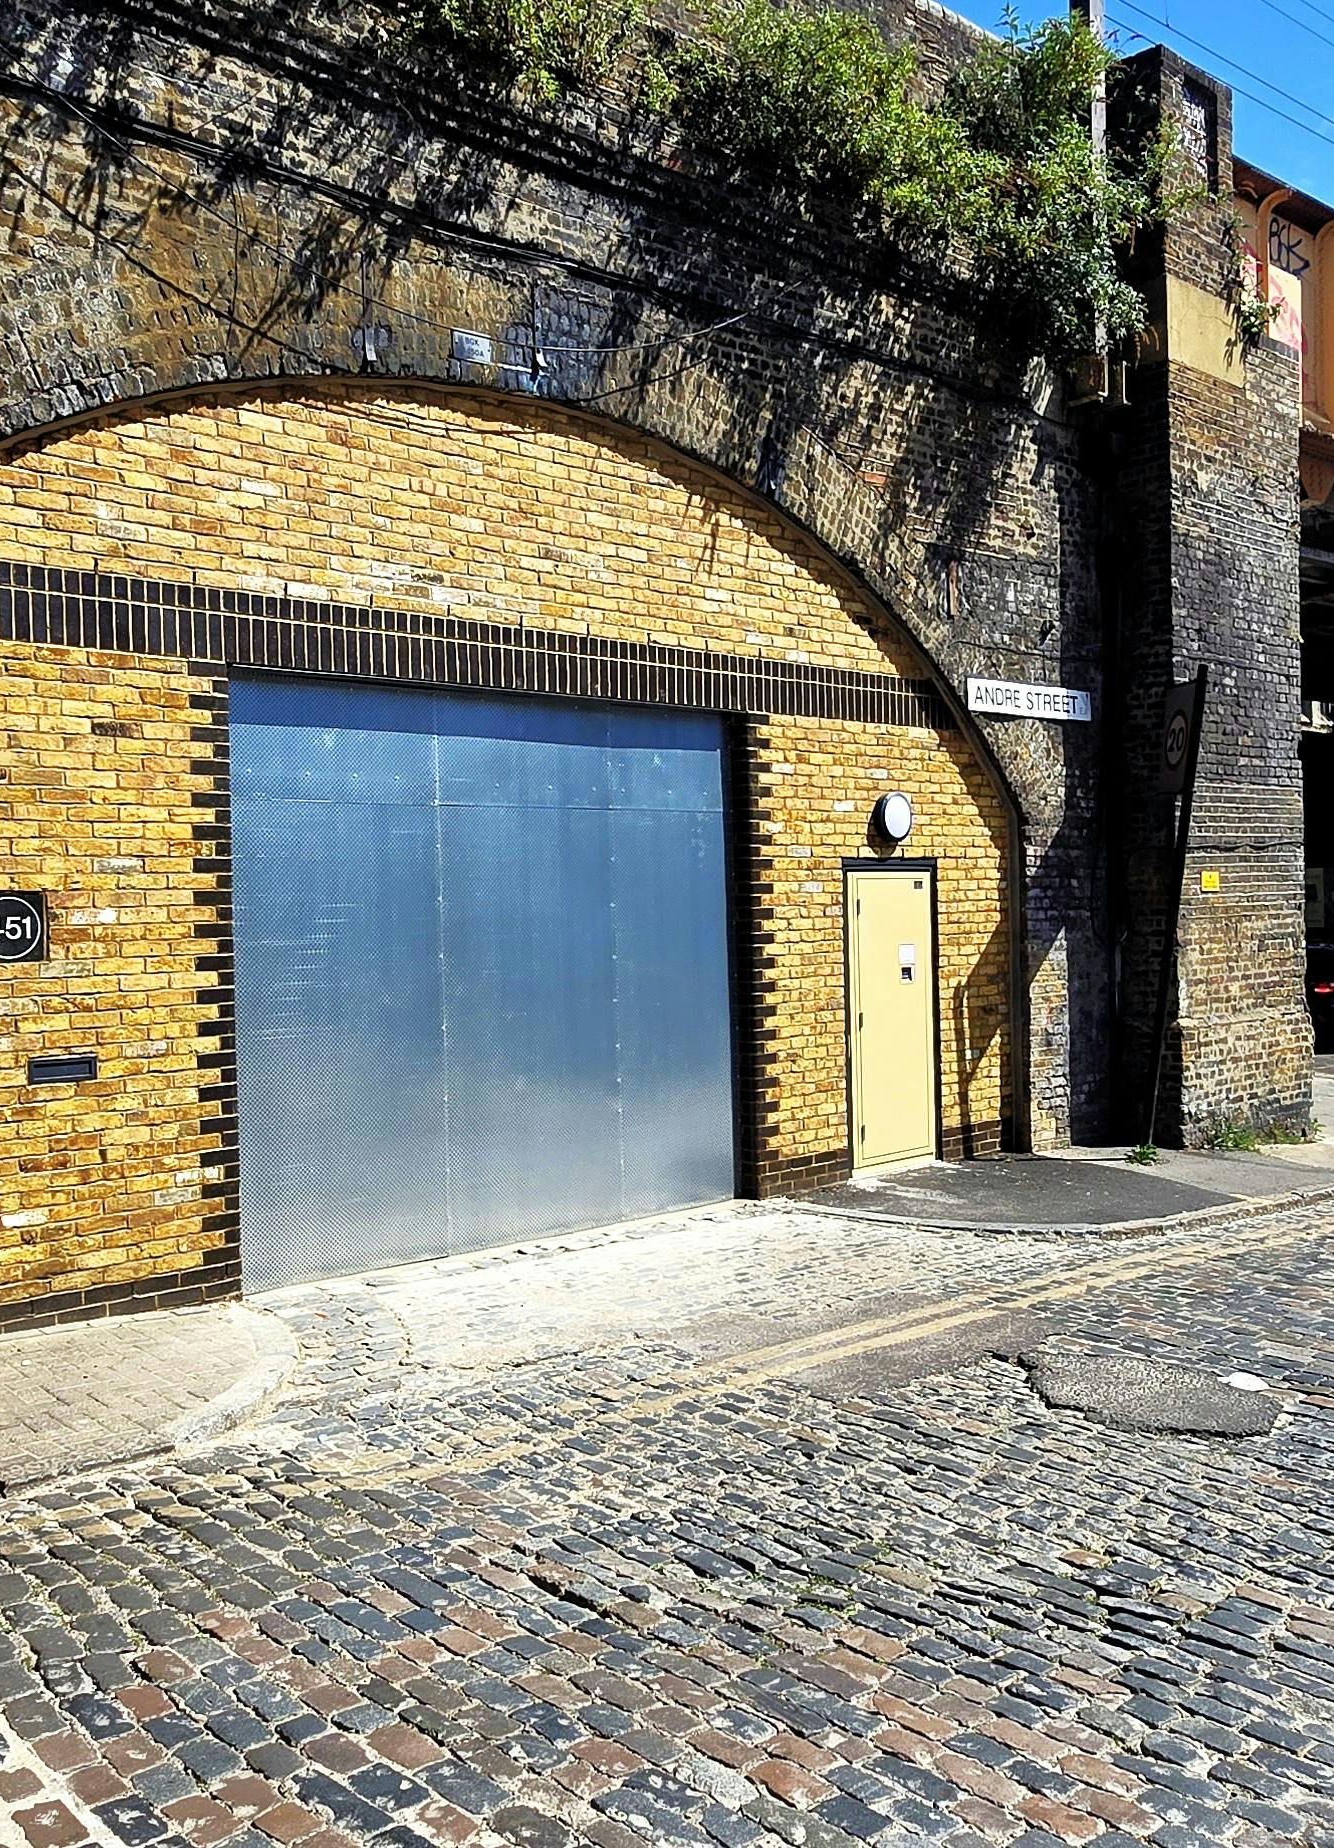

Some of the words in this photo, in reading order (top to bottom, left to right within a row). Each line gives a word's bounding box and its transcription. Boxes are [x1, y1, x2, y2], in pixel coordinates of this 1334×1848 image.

[974, 686, 1020, 708] ANDRE
[1027, 692, 1078, 714] STREET
[1167, 726, 1185, 752] 20
